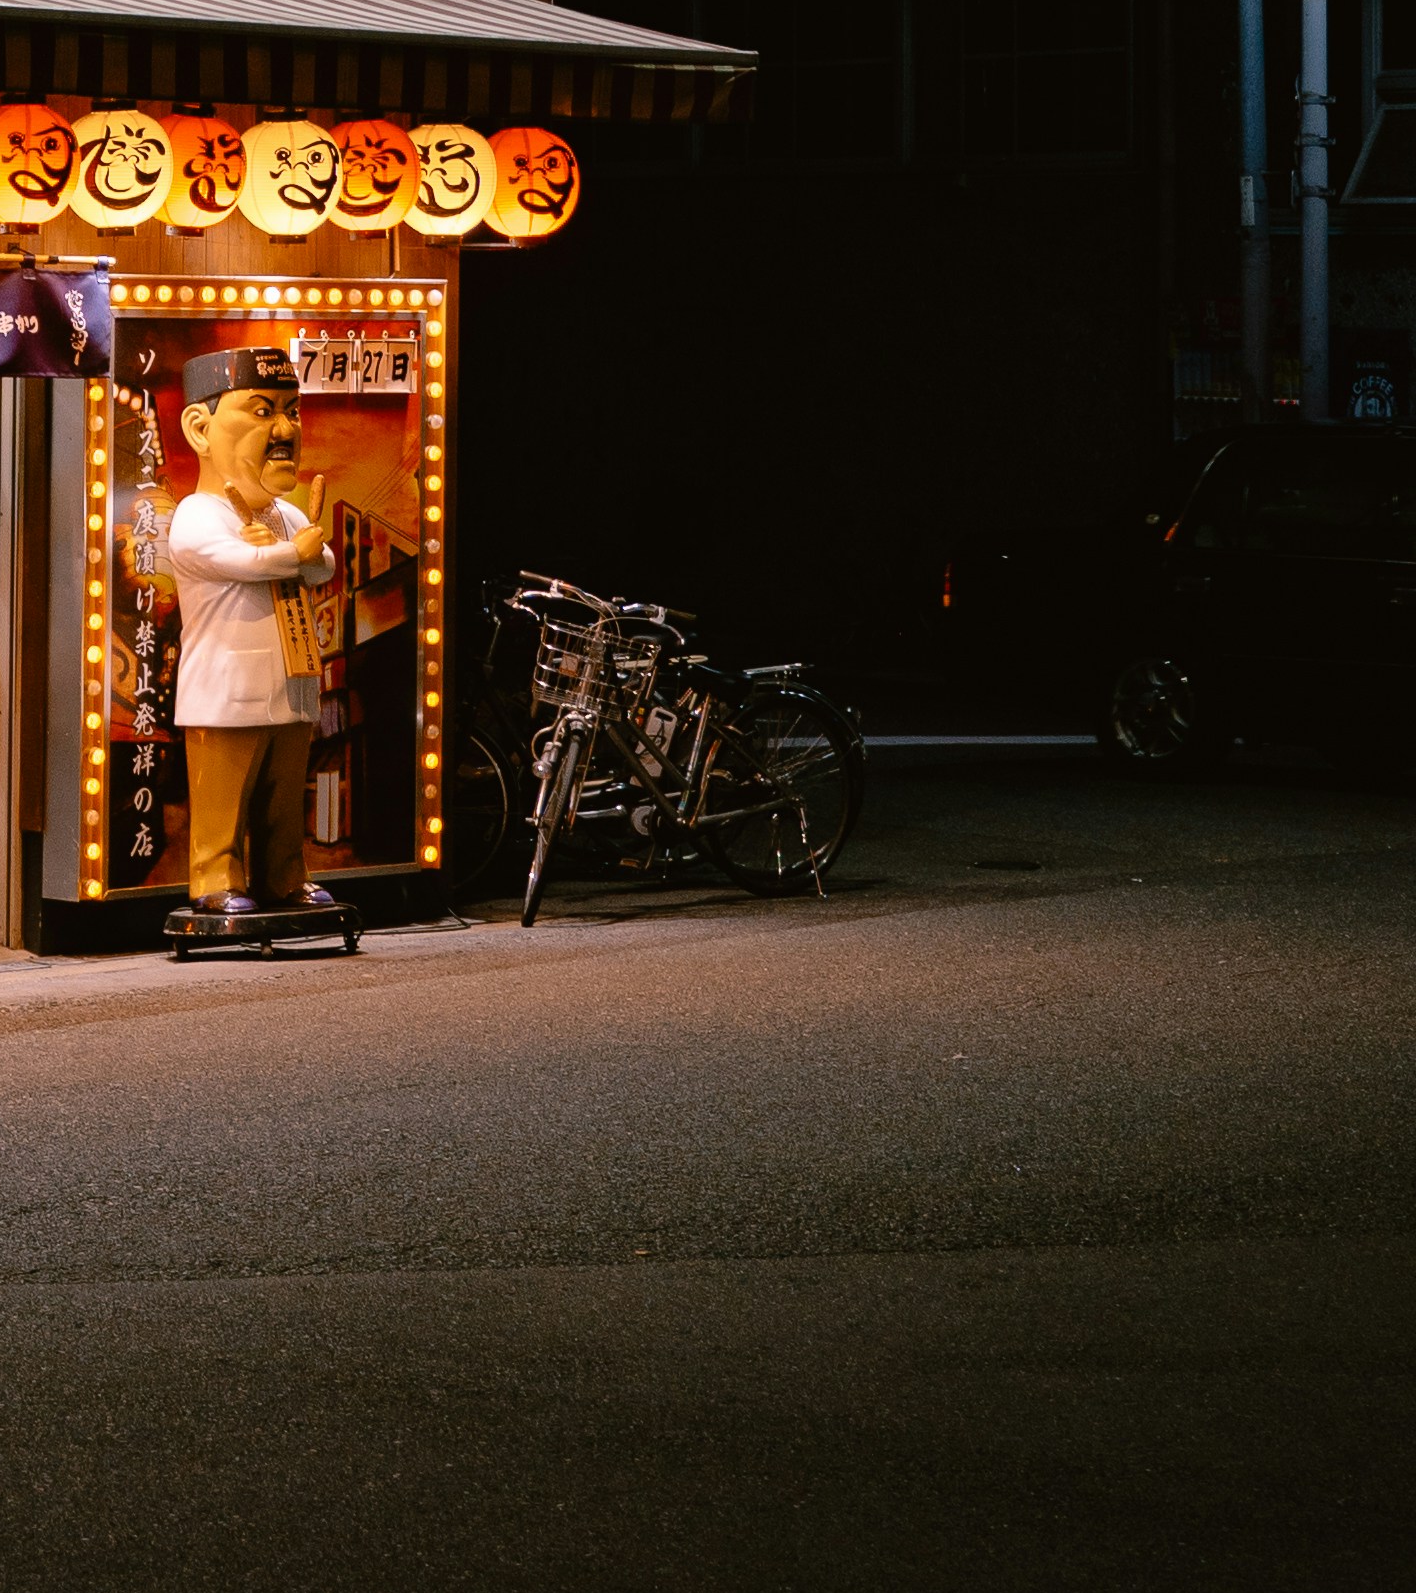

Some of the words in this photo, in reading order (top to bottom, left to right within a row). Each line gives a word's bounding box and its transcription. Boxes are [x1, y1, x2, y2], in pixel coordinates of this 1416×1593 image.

[129, 346, 161, 859] ソース二度漬け禁止発祥の店
